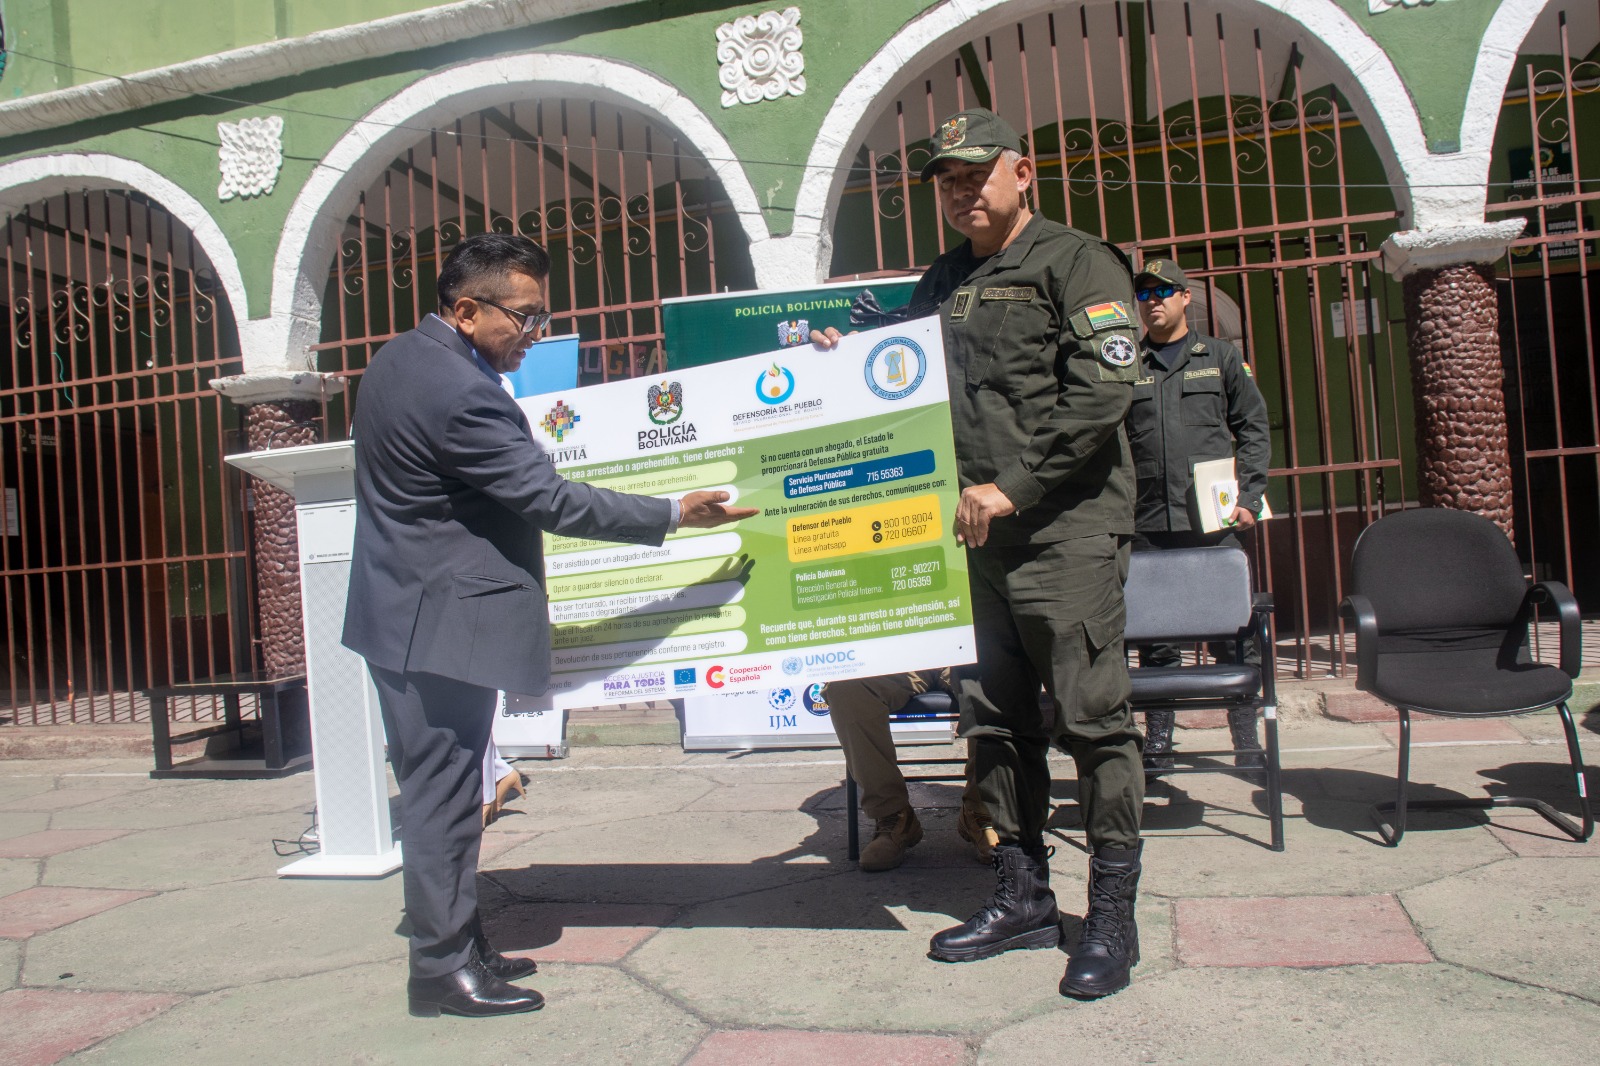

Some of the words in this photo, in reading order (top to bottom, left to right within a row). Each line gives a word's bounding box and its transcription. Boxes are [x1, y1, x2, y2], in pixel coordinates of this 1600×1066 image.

[735, 304, 783, 317] POLICIA
[787, 299, 852, 311] BOLIVIANA
[867, 344, 884, 367] SERVICIO
[883, 338, 922, 356] PLURINACIONAL
[878, 391, 903, 399] DEFENSA
[732, 406, 777, 421] DEFENSORÍA
[779, 405, 793, 413] DEL
[794, 398, 822, 410] PUEBLO
[637, 421, 697, 442] POLICÍA
[638, 433, 697, 450] BOLIVIANA
[761, 455, 767, 463] Si
[778, 450, 800, 461] cuenta
[801, 448, 814, 457] con
[815, 446, 823, 455] un
[824, 440, 855, 452] abogado,
[856, 438, 862, 446] el
[863, 434, 886, 445] Estado
[887, 432, 894, 440] le
[571, 470, 585, 479] sea
[586, 464, 623, 477] arrestado
[683, 452, 703, 463] tiene
[704, 446, 736, 459] derecho
[737, 446, 745, 454] a:
[762, 460, 808, 476] proporcionará
[809, 456, 836, 467] Defensa
[837, 449, 860, 462] Pública
[862, 446, 889, 458] gratuita
[788, 474, 814, 486] Servicio
[814, 467, 853, 481] Plurinacional
[866, 470, 880, 482] 715
[880, 466, 904, 480] 55363
[627, 481, 651, 490] arresto
[789, 487, 798, 495] de
[798, 484, 823, 494] Defensa
[823, 480, 846, 490] Pública
[764, 508, 780, 517] Ante
[781, 506, 787, 514] la
[788, 500, 828, 512] vulneración
[828, 498, 837, 507] de
[838, 496, 850, 505] sus
[851, 491, 885, 503] derechos,
[885, 482, 931, 497] comuníquese
[931, 479, 947, 488] con:
[792, 522, 819, 532] Defensor
[820, 519, 830, 528] del
[831, 516, 852, 526] Pueblo
[812, 530, 840, 542] gratuita
[883, 517, 900, 529] 800
[901, 515, 910, 526] 10
[911, 511, 933, 524] 8004
[813, 541, 847, 553] whatsapp
[884, 529, 900, 541] 720
[552, 561, 563, 570] Ser
[564, 559, 590, 568] asistido
[590, 558, 601, 566] por
[613, 552, 640, 563] abogado
[817, 568, 846, 579] Boliviana
[913, 561, 940, 575] 902271
[553, 584, 571, 594] Optar
[577, 581, 602, 592] guardar
[604, 577, 629, 588] silencio
[796, 583, 825, 595] Dirección
[825, 579, 848, 590] General
[849, 579, 857, 587] de
[892, 579, 907, 591] 720
[907, 575, 932, 588] 05359
[553, 604, 562, 612] No
[616, 596, 637, 605] recibir
[797, 592, 837, 605] Investigación
[837, 588, 859, 598] Policial
[553, 610, 590, 621] inhumanos
[603, 623, 612, 632] 24
[613, 621, 632, 631] horas
[633, 620, 642, 628] de
[652, 612, 693, 626] aprehensión
[701, 609, 732, 621] presente
[760, 621, 797, 634] Recuerde
[798, 620, 815, 630] que,
[816, 614, 847, 627] durante
[848, 614, 857, 622] su
[858, 608, 887, 621] arresto
[895, 600, 947, 617] aprehensión,
[948, 596, 960, 608] así
[765, 636, 787, 646] como
[788, 632, 808, 643] tiene
[848, 621, 881, 635] también
[882, 620, 903, 631] tiene
[904, 612, 957, 628] obligaciones.
[591, 653, 600, 661] de
[601, 652, 613, 660] sus
[613, 648, 658, 660] pertenencias
[658, 644, 691, 654] conforme
[805, 650, 856, 666] UNODC
[729, 664, 772, 675] Cooperación
[603, 680, 631, 690] PARA
[729, 674, 761, 684] Española
[769, 715, 797, 730] IJM
